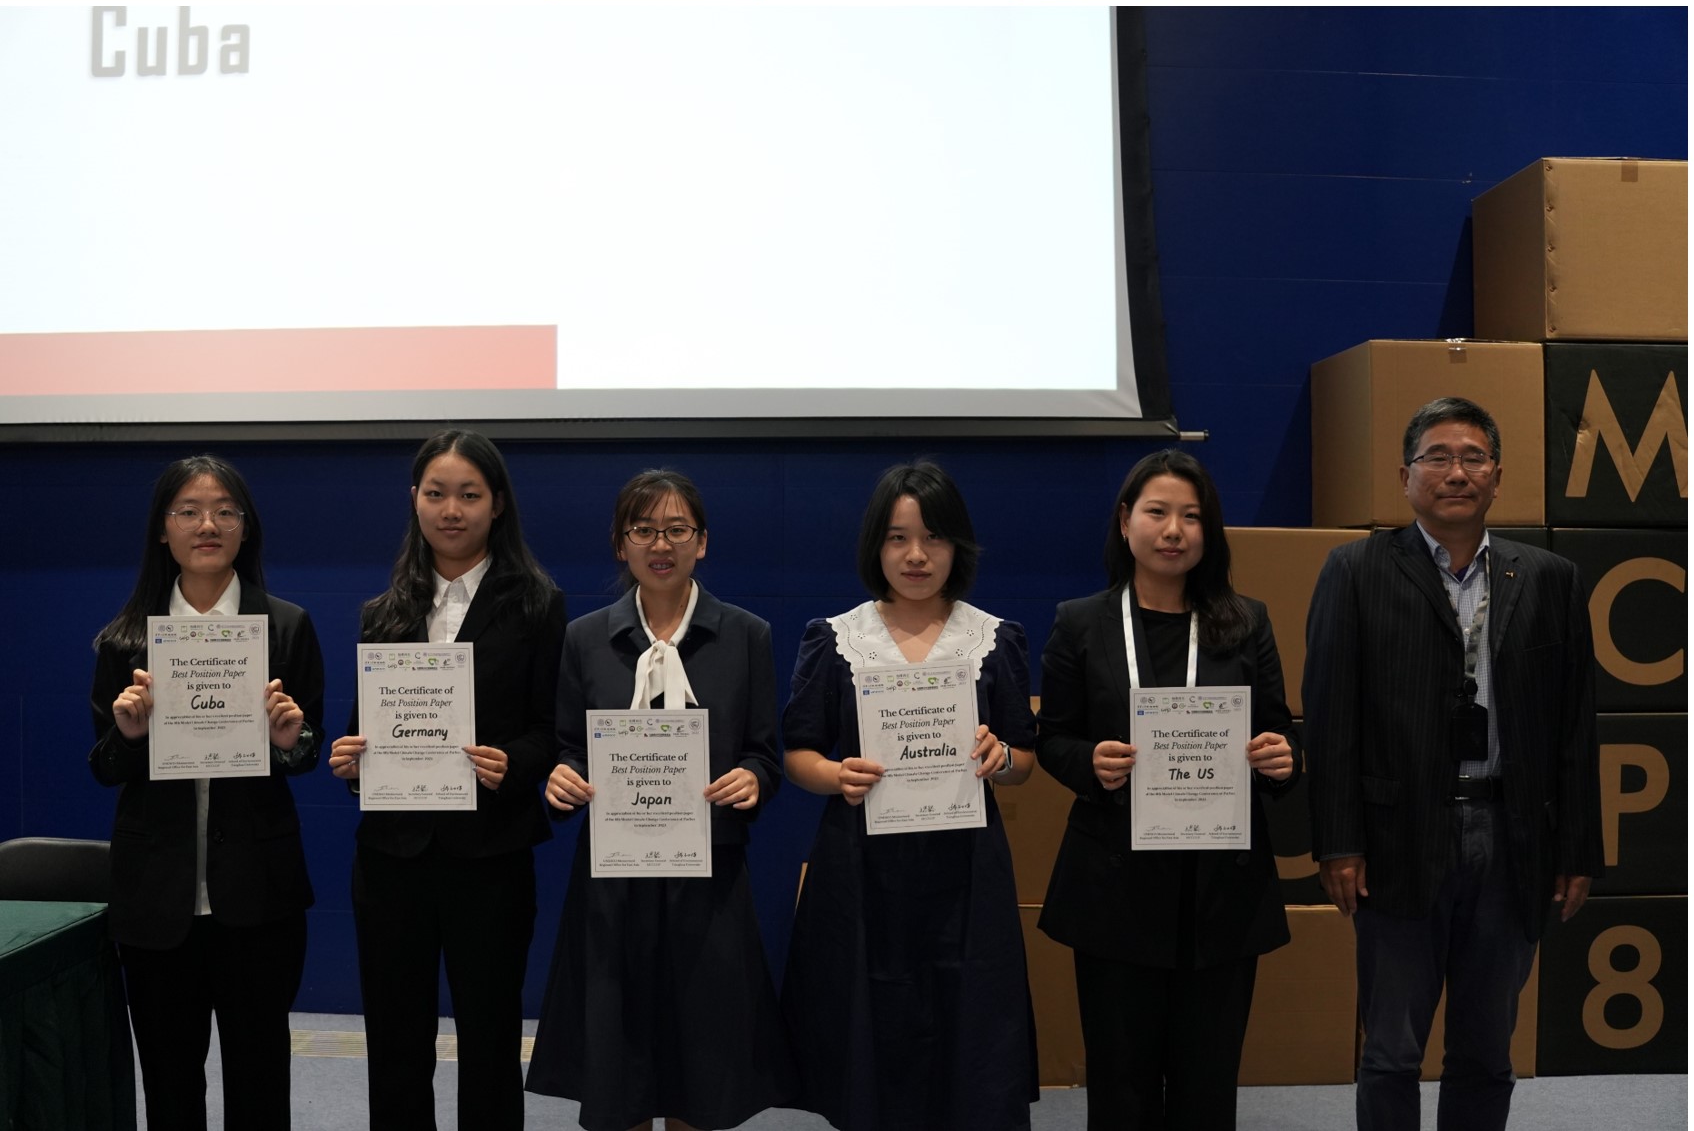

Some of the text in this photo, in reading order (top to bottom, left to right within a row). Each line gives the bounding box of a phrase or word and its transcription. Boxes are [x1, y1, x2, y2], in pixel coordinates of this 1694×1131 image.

[90, 6, 251, 77] Cuba
[1565, 370, 1687, 503] M
[1588, 557, 1686, 686] C
[170, 657, 248, 666] The Certificate of
[171, 669, 246, 679] Best Position Paper
[187, 682, 194, 690] is
[196, 683, 220, 692] given
[379, 686, 454, 695] The Certificate of
[191, 695, 225, 710] Cuba
[381, 698, 452, 708] Best Position Paper
[878, 704, 956, 717] The Certificate of
[403, 713, 427, 721] given
[882, 718, 955, 730] Best Position Paper
[392, 724, 448, 741] Germany
[898, 733, 904, 741] is
[906, 732, 930, 742] given
[1152, 729, 1229, 738] The Certificate of
[1153, 741, 1228, 751] Best Position Paper
[900, 743, 956, 760] Australia
[609, 753, 688, 761] The Certificate of
[1177, 755, 1201, 763] given
[611, 766, 627, 774] Best
[663, 766, 686, 775] Paper
[1168, 768, 1214, 780] The US
[636, 780, 660, 788] given
[631, 792, 671, 809] Japan
[1599, 744, 1670, 867] P
[1582, 925, 1664, 1049] 8
